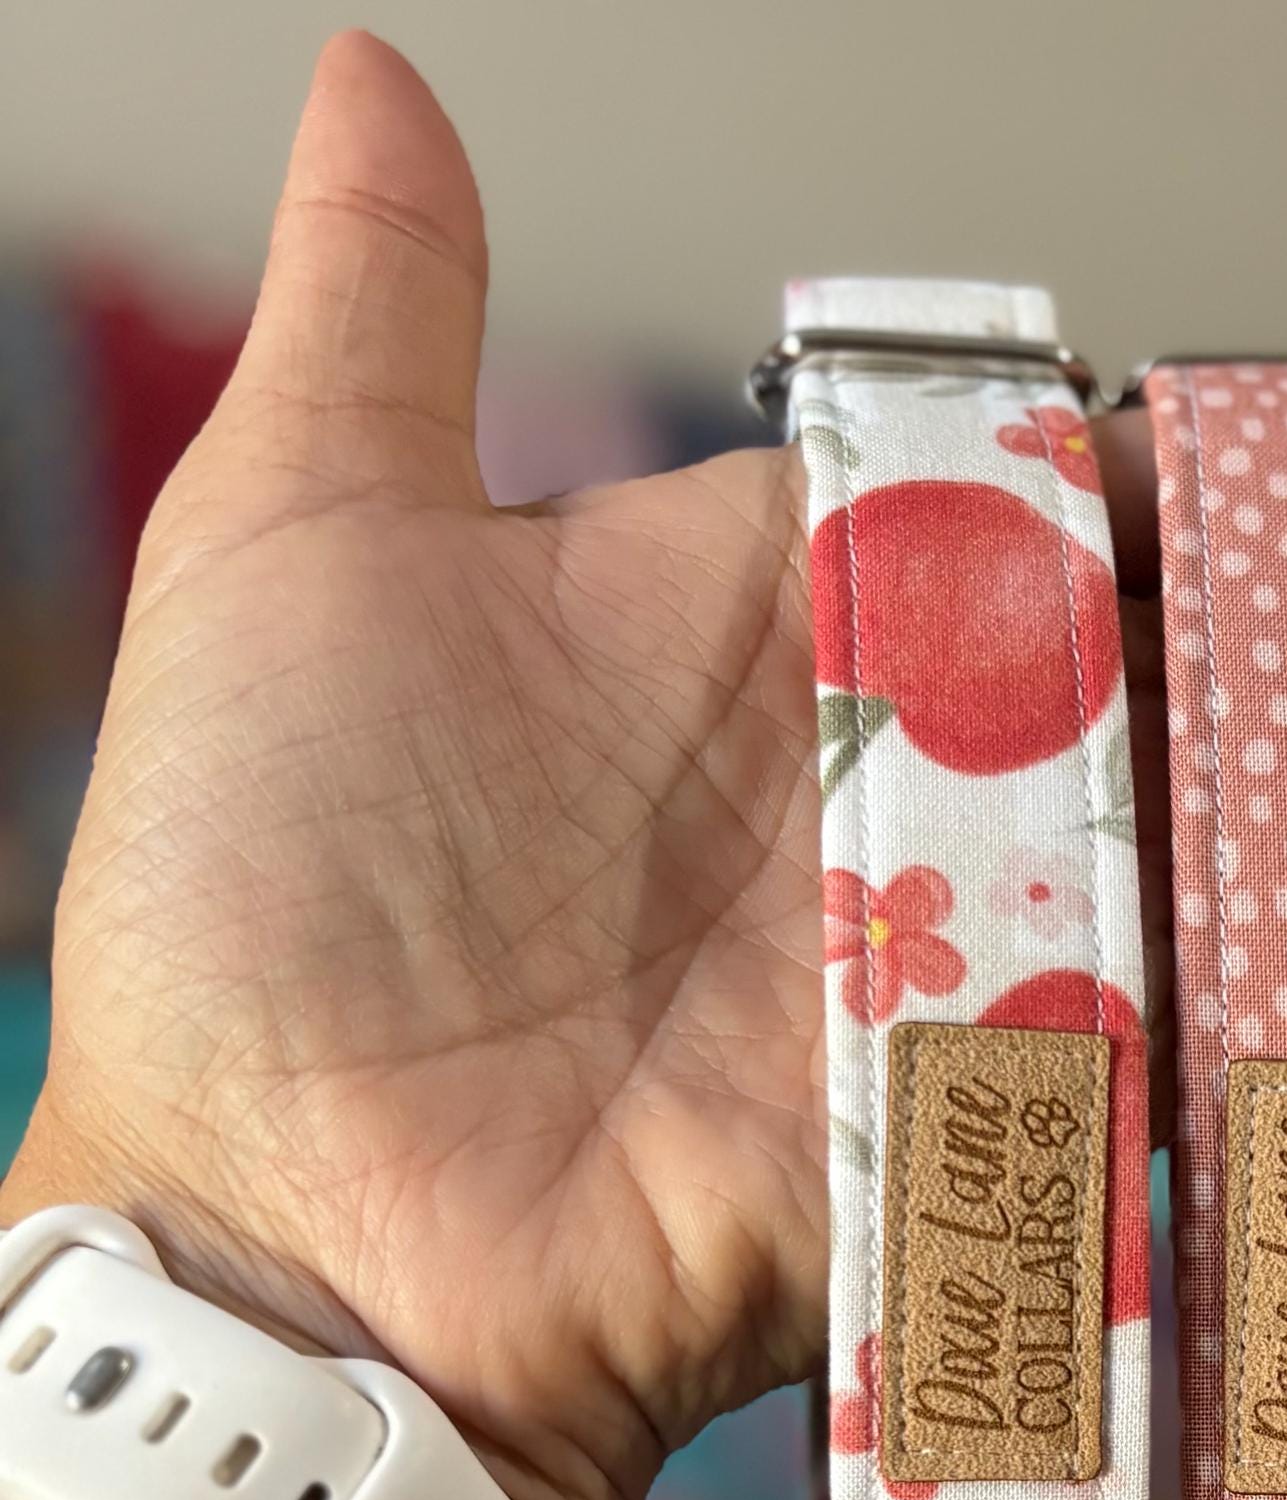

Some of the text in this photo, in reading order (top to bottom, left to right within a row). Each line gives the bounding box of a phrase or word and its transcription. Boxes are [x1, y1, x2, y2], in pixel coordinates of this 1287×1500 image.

[910, 1075, 1012, 1431] Dixie Lane
[1016, 1174, 1077, 1435] COLLARS
